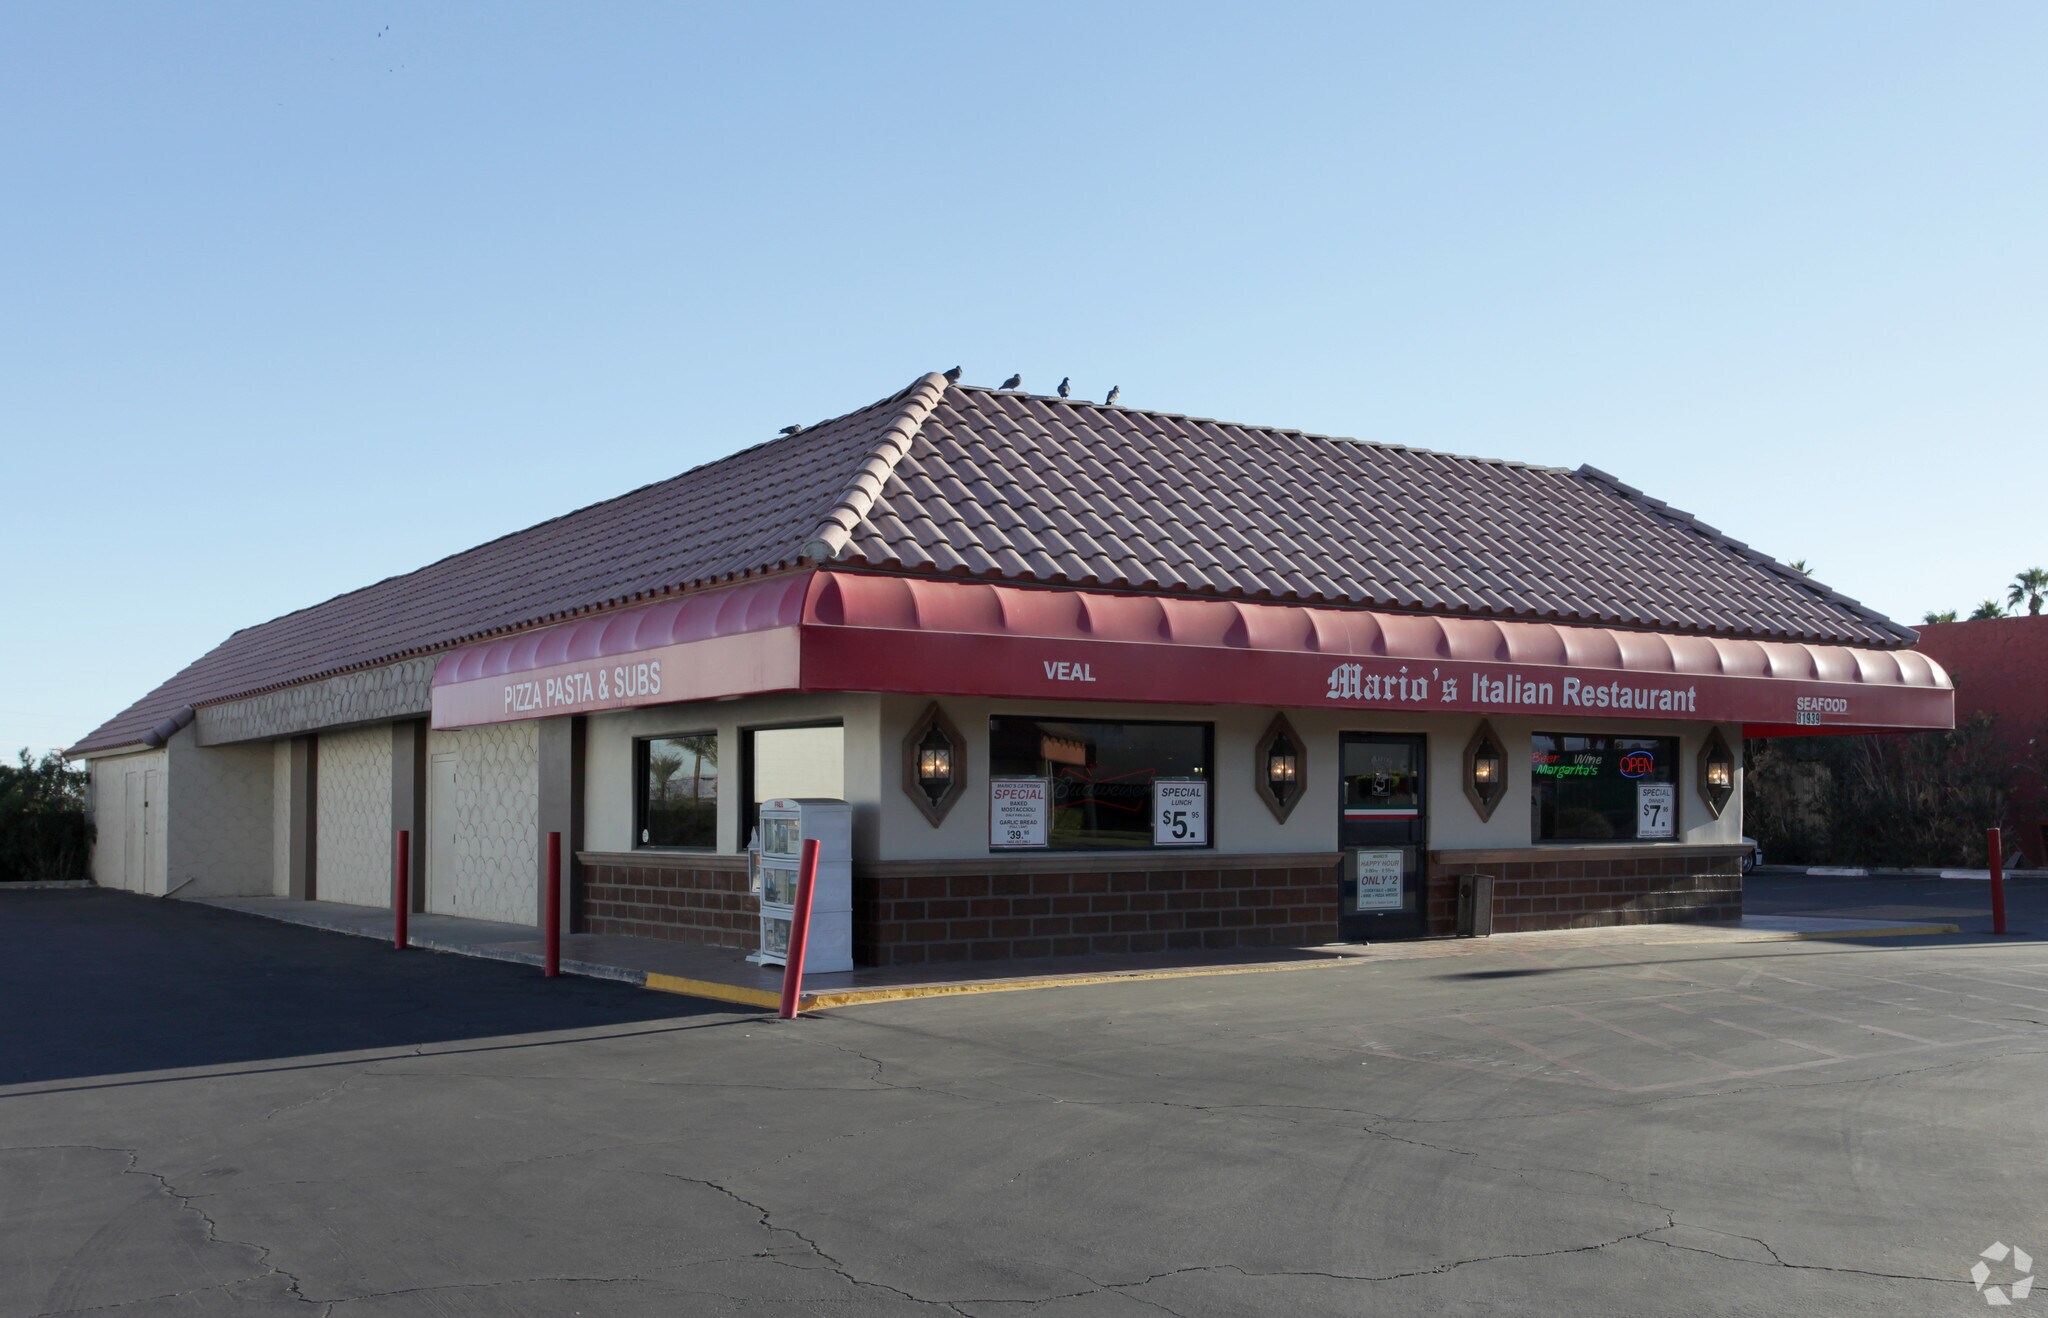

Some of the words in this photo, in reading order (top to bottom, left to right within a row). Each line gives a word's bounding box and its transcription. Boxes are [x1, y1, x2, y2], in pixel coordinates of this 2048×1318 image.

[1043, 660, 1096, 682] VEAL
[504, 681, 543, 714] PIZZA
[546, 671, 594, 707] PASTA
[598, 669, 610, 700] &
[614, 661, 661, 698] SUBS
[1326, 663, 1458, 701] Mario's
[1472, 672, 1553, 705] Italian
[1562, 677, 1696, 712] Restaurant
[1796, 696, 1848, 712] SEAFOOD
[1797, 711, 1821, 725] 81939
[1532, 751, 1560, 763] Beer
[1574, 753, 1603, 765] Wine
[1619, 756, 1654, 773] OPEN
[1536, 764, 1599, 779] Margarita's
[994, 789, 1044, 800] SPECIAL
[1161, 787, 1202, 798] SPECIAL
[1642, 788, 1671, 797] SPECIAL
[774, 800, 784, 808] FREE
[1382, 859, 1400, 867] HOUR
[1361, 875, 1388, 886] ONLY
